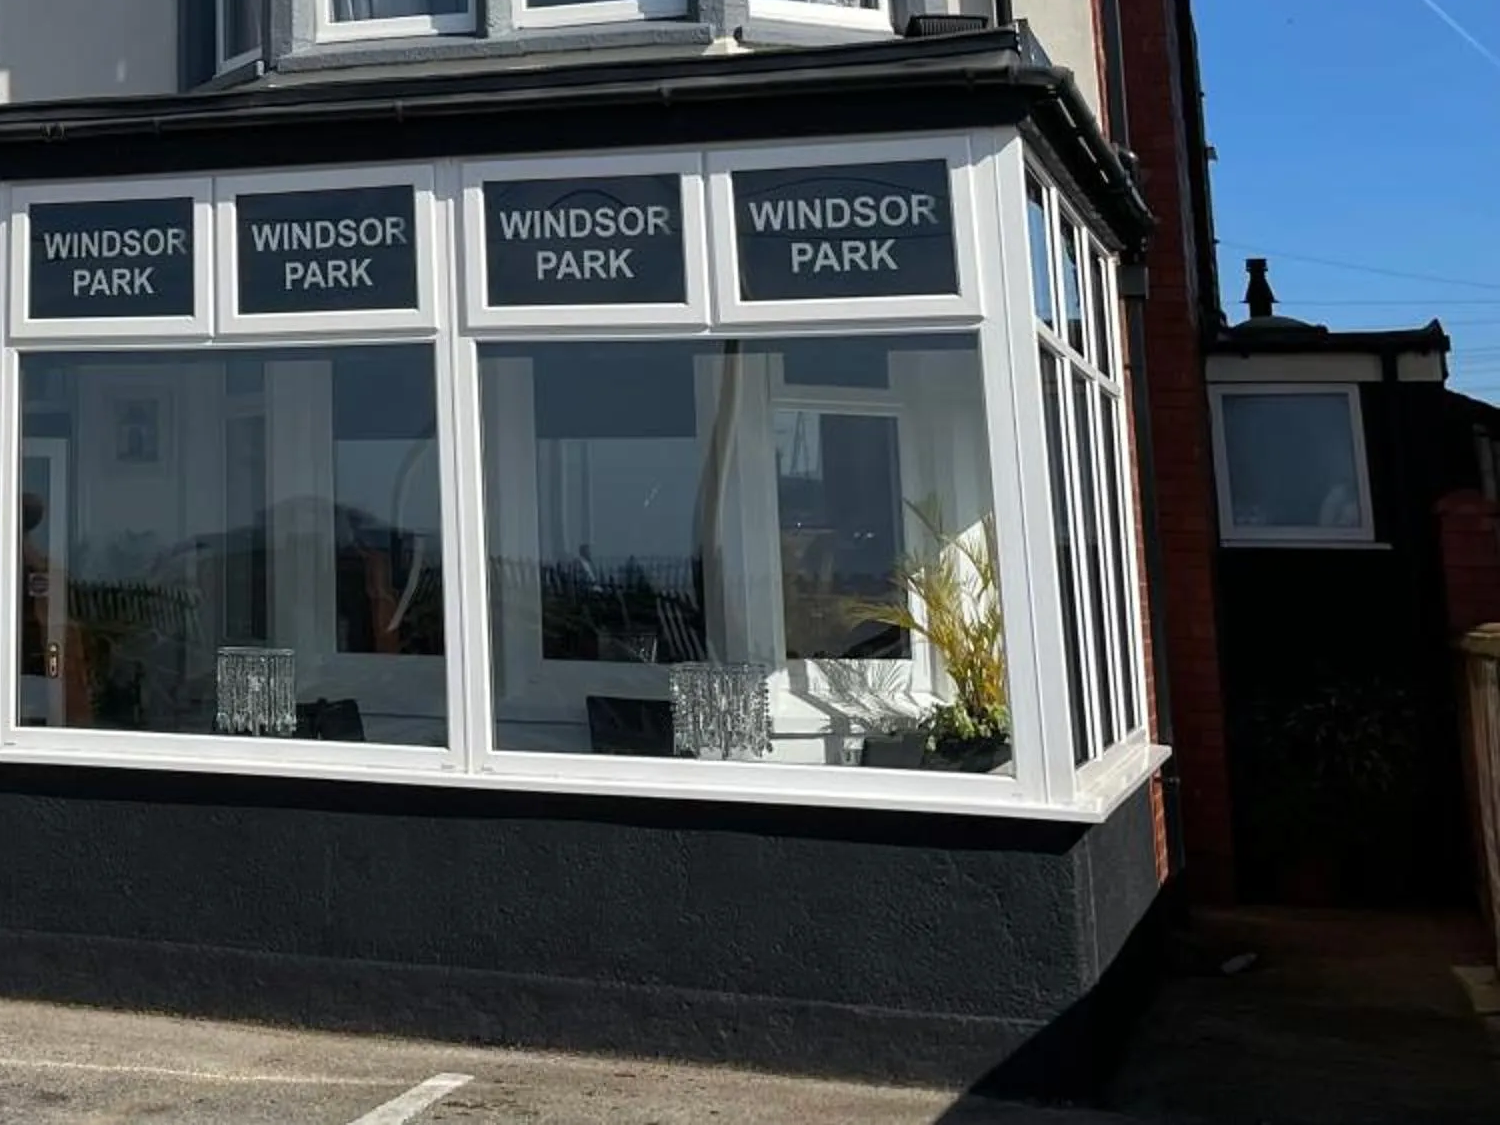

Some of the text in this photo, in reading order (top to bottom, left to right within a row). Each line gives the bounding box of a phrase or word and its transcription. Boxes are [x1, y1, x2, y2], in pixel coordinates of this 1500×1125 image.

[500, 206, 672, 240] WINDSOR
[749, 194, 938, 232] WINDSOR
[44, 228, 187, 259] WINDSOR
[252, 217, 407, 252] WINDSOR
[536, 248, 634, 280] PARK
[791, 239, 898, 273] PARK
[73, 267, 154, 296] PARK
[284, 258, 373, 290] PARK
